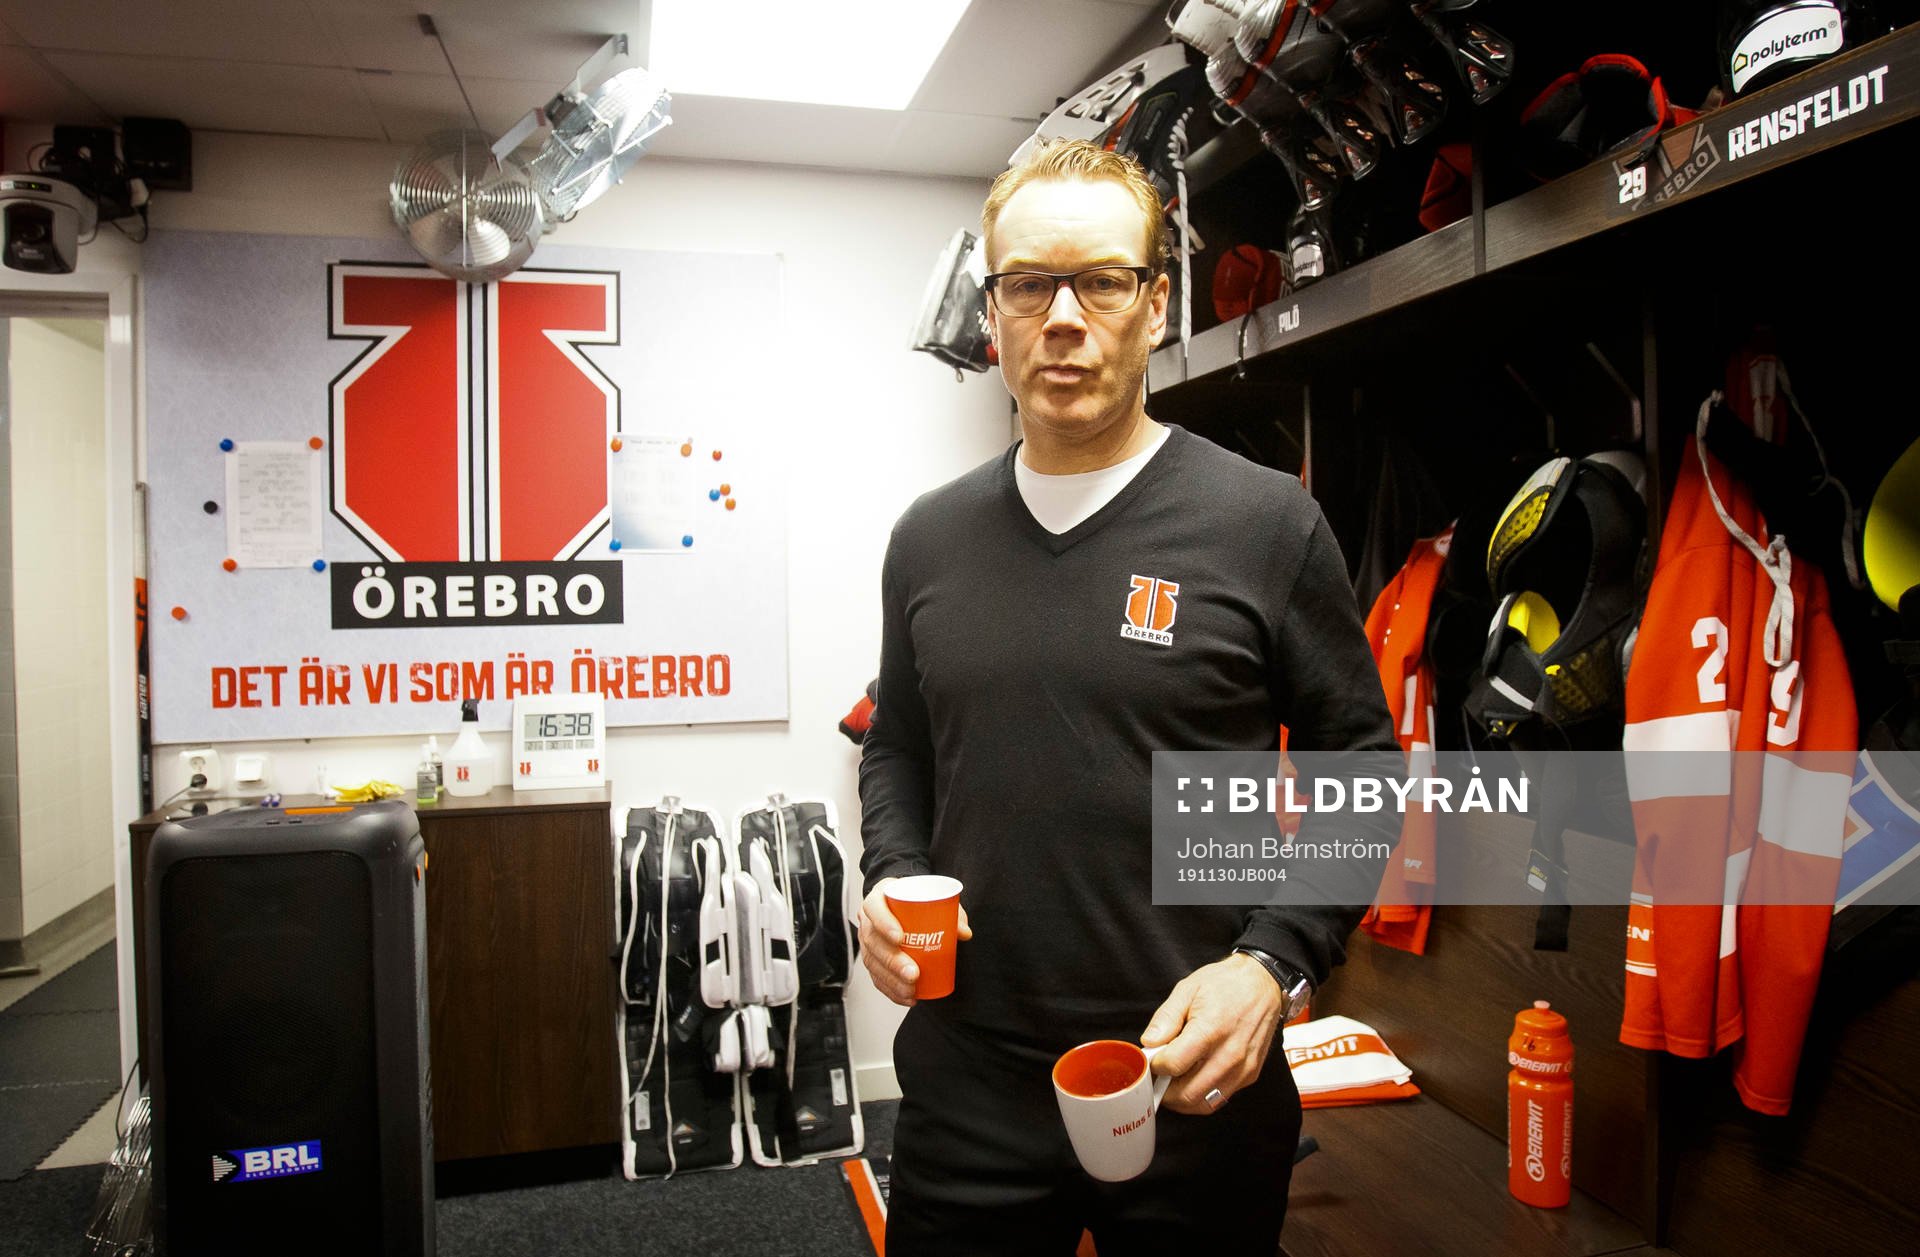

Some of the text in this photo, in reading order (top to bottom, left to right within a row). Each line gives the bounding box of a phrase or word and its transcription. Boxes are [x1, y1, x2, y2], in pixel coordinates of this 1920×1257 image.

[1750, 27, 1827, 67] polyterm
[1728, 65, 1888, 162] RENSFELDT
[1618, 165, 1647, 204] 29
[352, 565, 606, 619] ÖREBRO
[1125, 626, 1171, 644] ÖREBRO
[211, 648, 731, 709] DET ÄR VI SOM ÄR ÖREBRO
[902, 930, 945, 946] NERVIT
[1287, 1035, 1359, 1065] ERVIT
[1112, 1115, 1146, 1137] Niklas
[1527, 1098, 1544, 1159] ENERVIT
[244, 1145, 319, 1173] BRL
